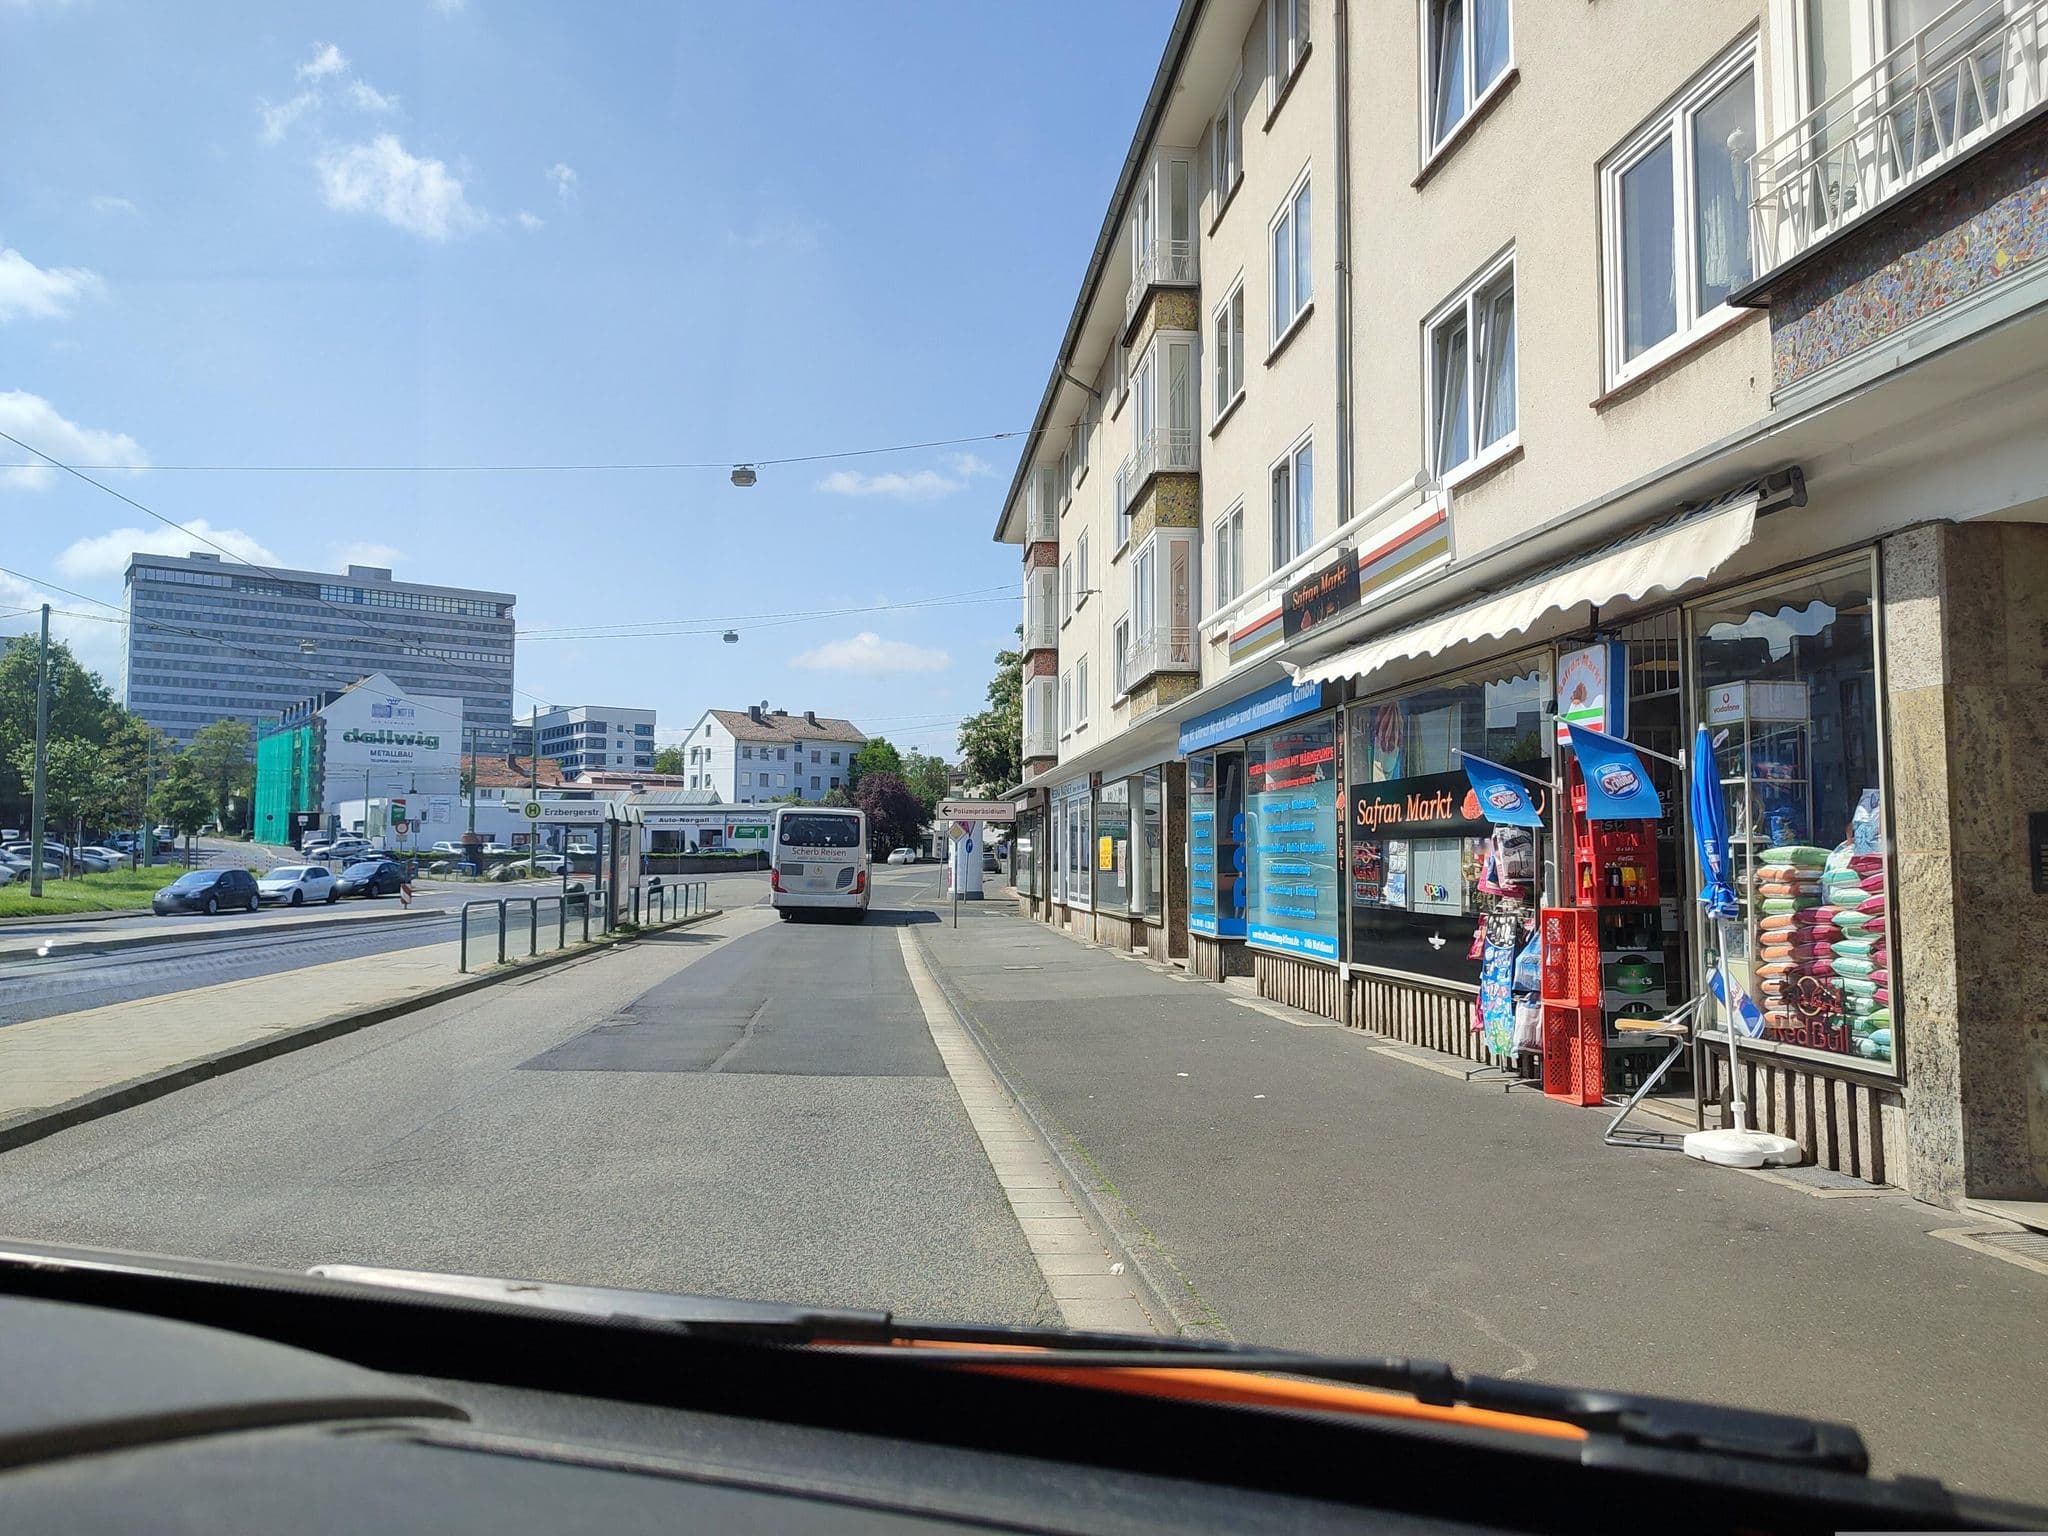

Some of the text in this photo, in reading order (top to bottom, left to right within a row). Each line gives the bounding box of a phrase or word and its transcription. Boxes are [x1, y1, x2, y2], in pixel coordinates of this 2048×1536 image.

[1292, 564, 1347, 611] Safran Markt
[1712, 704, 1740, 714] vodafone
[342, 728, 440, 750] dallwig
[369, 749, 414, 758] METALLBAU
[544, 807, 601, 818] Erzbergerstr.
[953, 807, 1007, 816] Polizeipräsidium
[1356, 796, 1402, 832] Safran
[1405, 790, 1453, 822] Markt
[791, 847, 847, 857] Scherb Reisen
[1774, 1015, 1850, 1054] Red Bull
